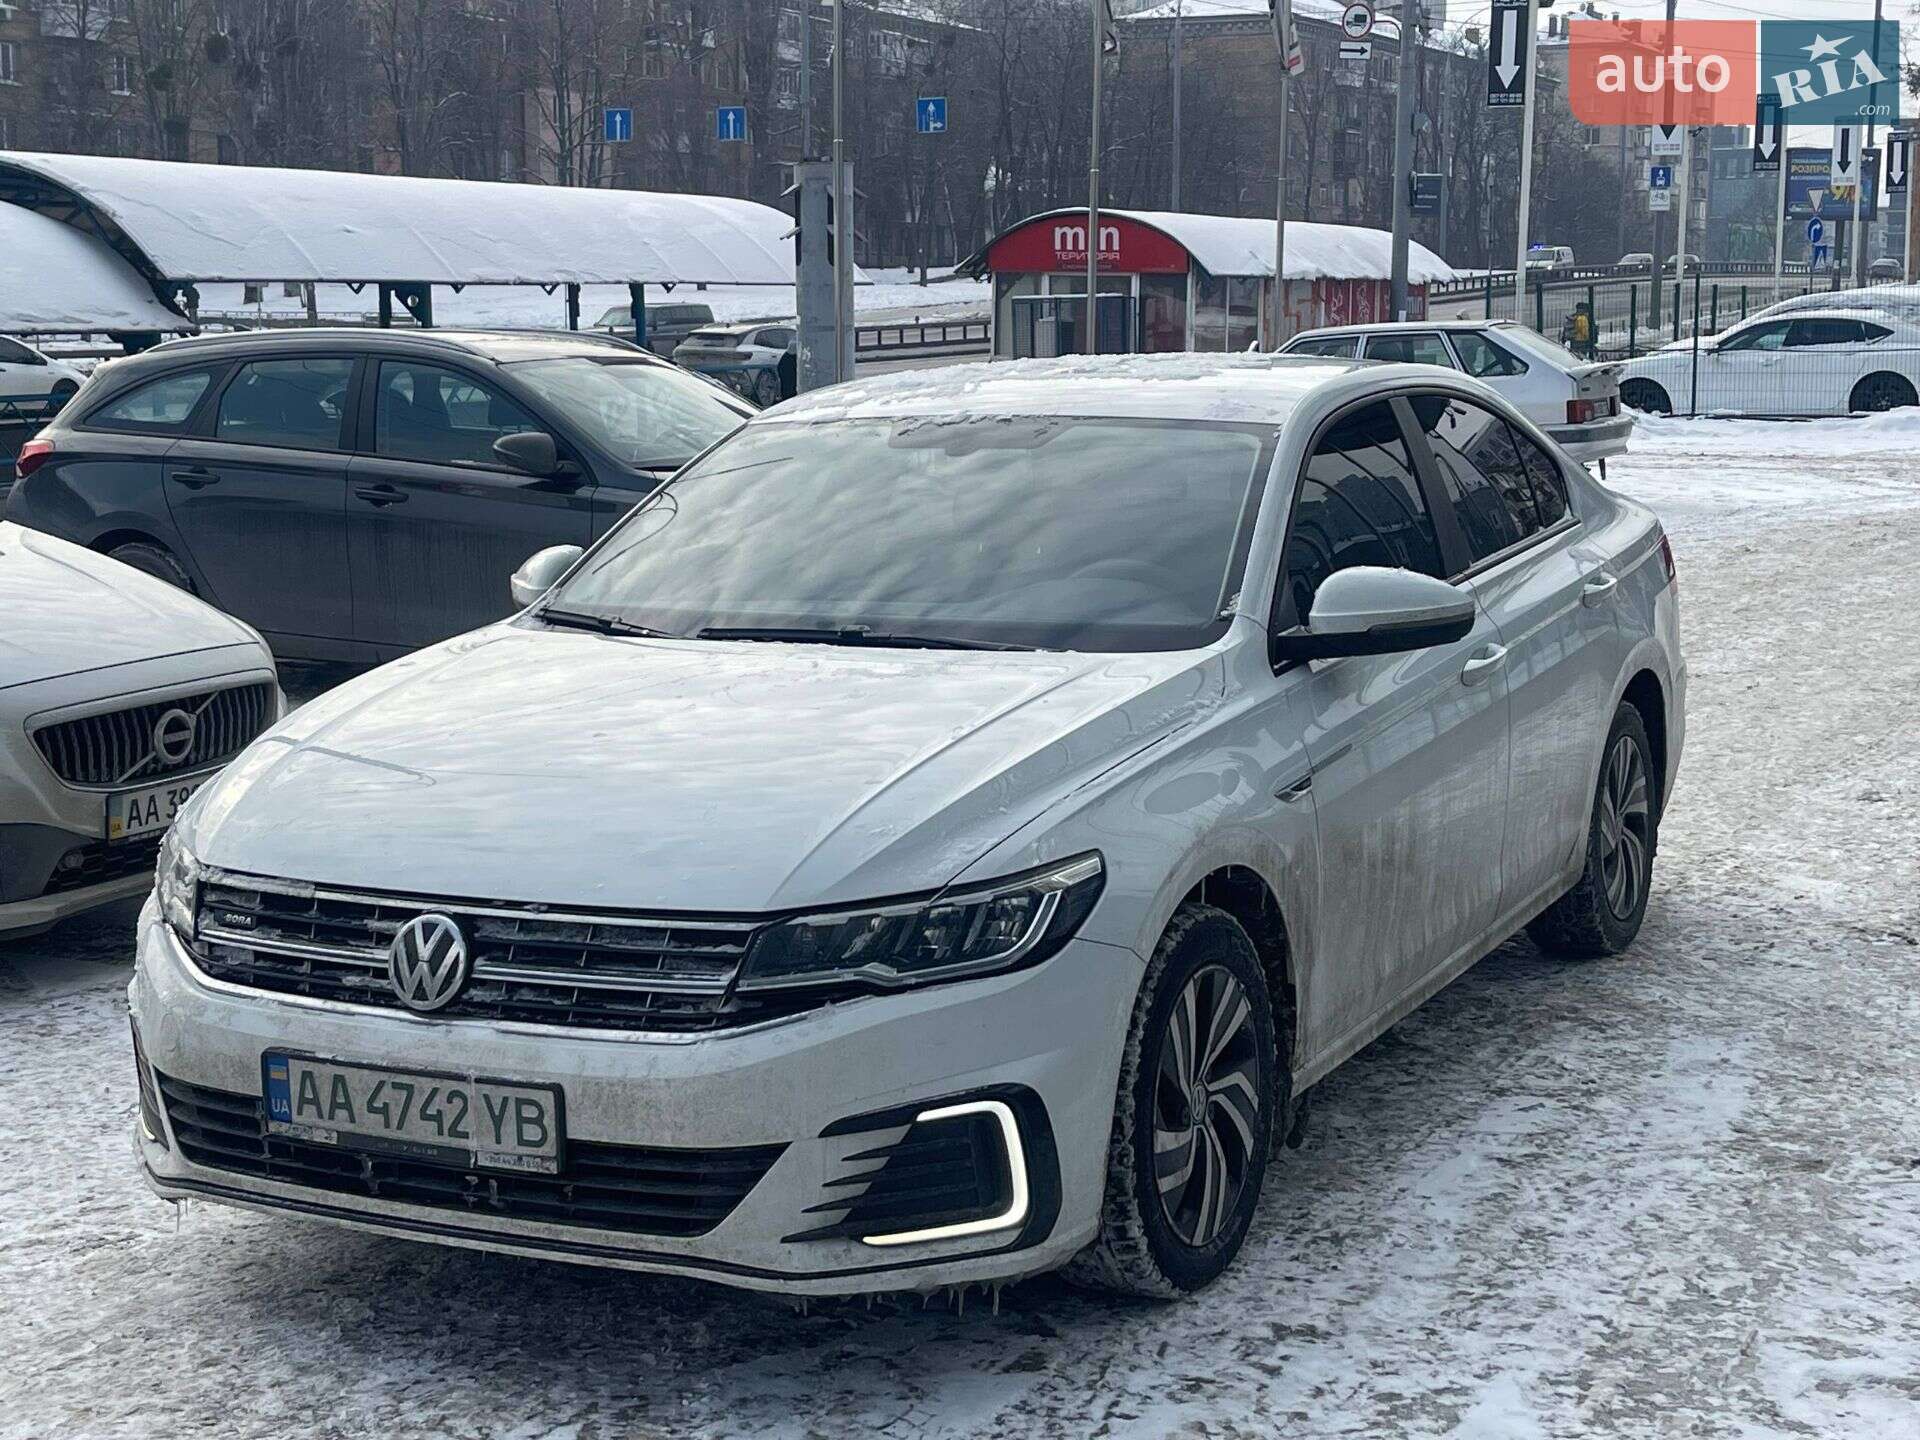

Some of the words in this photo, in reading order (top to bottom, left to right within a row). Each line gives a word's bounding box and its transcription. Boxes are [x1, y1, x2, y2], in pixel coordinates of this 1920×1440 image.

[1791, 165, 1831, 174] РОЗПРО
[1054, 226, 1120, 251] mn
[126, 794, 161, 830] AA
[271, 1096, 291, 1116] UA
[296, 1070, 356, 1123] AA
[366, 1080, 470, 1140] 4742
[482, 1093, 549, 1148] YB
